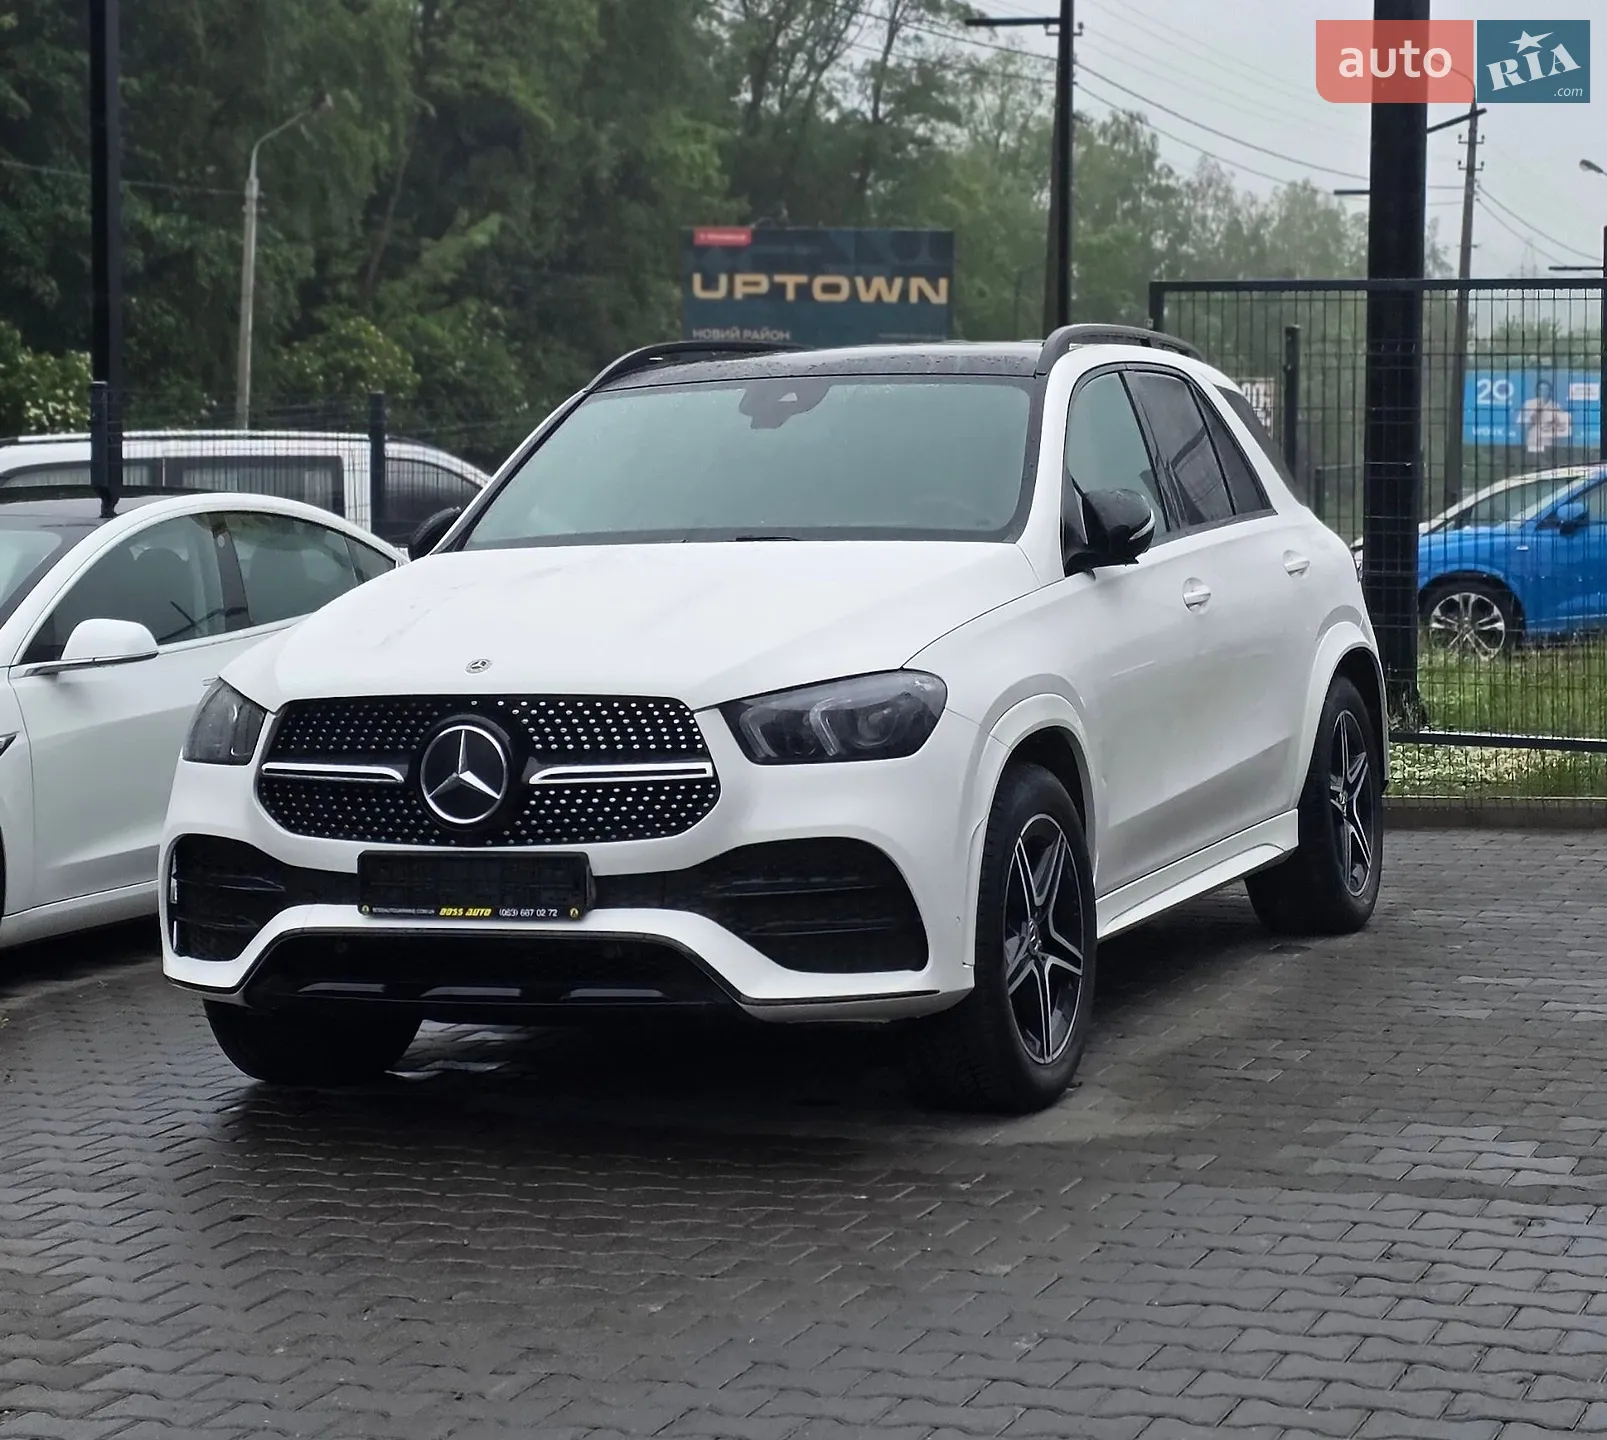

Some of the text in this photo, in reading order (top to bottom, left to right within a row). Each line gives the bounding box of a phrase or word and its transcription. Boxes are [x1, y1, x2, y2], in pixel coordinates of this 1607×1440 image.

[692, 272, 948, 305] UPTOWN
[693, 327, 791, 341] НОВИЙ РАЙОН
[465, 908, 492, 917] AUTO
[536, 908, 547, 917] 02
[548, 908, 558, 917] 72
